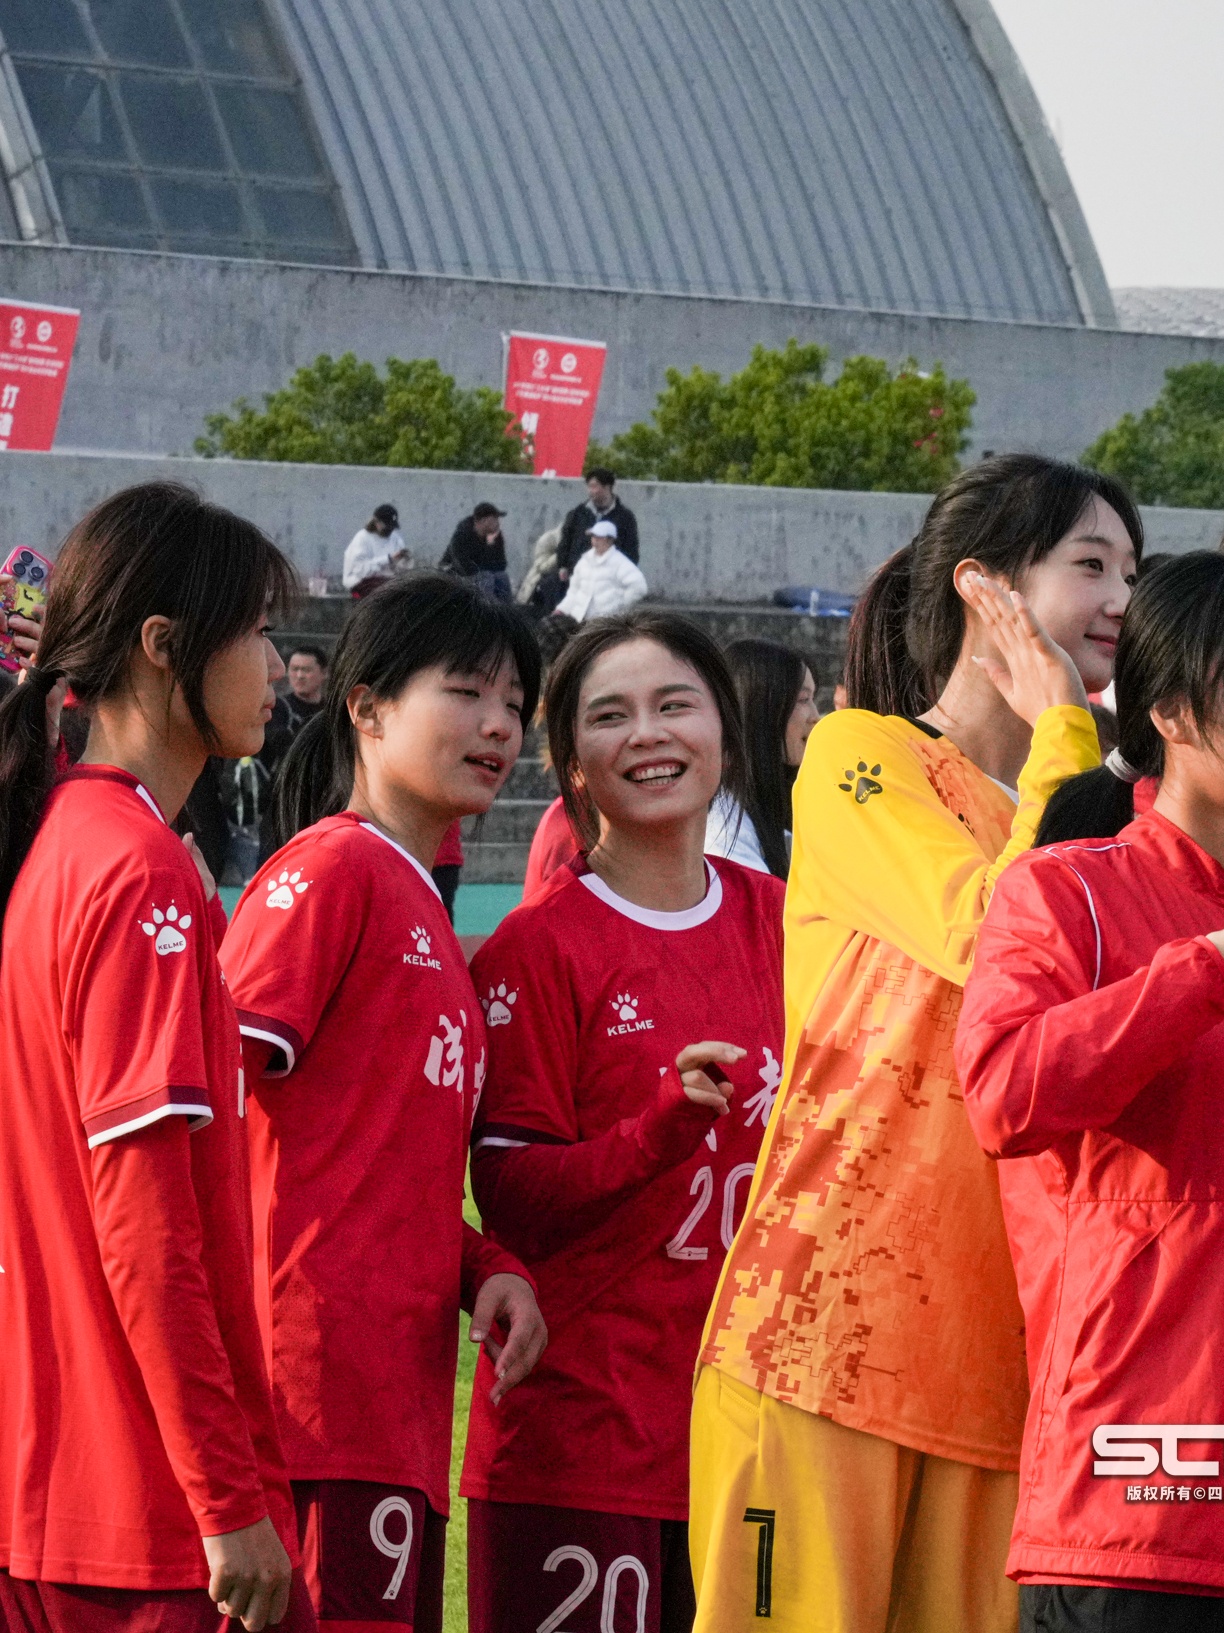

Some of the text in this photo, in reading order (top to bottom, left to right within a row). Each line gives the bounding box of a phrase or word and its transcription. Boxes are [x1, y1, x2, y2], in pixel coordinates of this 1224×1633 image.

[157, 940, 185, 951] KELME
[403, 953, 442, 971] KELME
[488, 1014, 510, 1022] KELME
[606, 1019, 655, 1037] KELME
[665, 1162, 756, 1261] 20
[369, 1496, 414, 1600] 9
[742, 1507, 776, 1618] 1
[535, 1544, 650, 1633] 20
